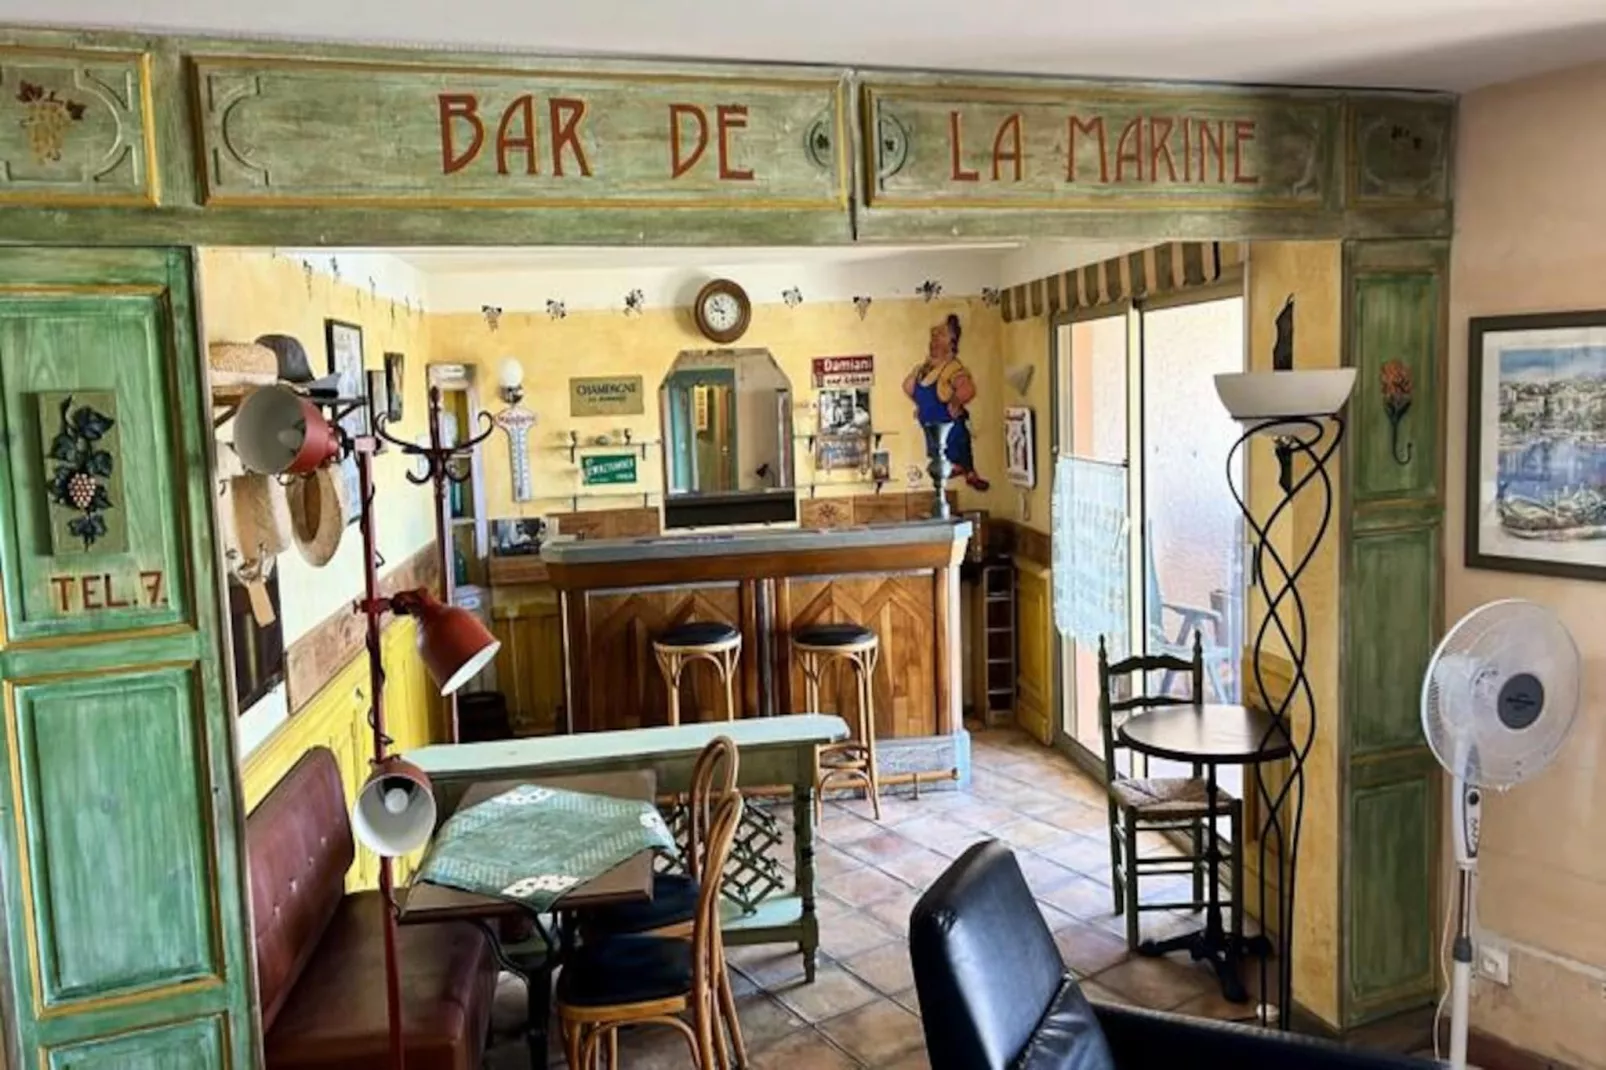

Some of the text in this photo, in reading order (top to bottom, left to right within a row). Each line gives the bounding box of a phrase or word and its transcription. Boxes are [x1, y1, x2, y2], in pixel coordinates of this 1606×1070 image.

[438, 94, 754, 179] BAR DE
[950, 111, 1259, 183] LA MARINE
[823, 358, 872, 372] Damiani
[576, 383, 636, 396] CHAMPAGNE
